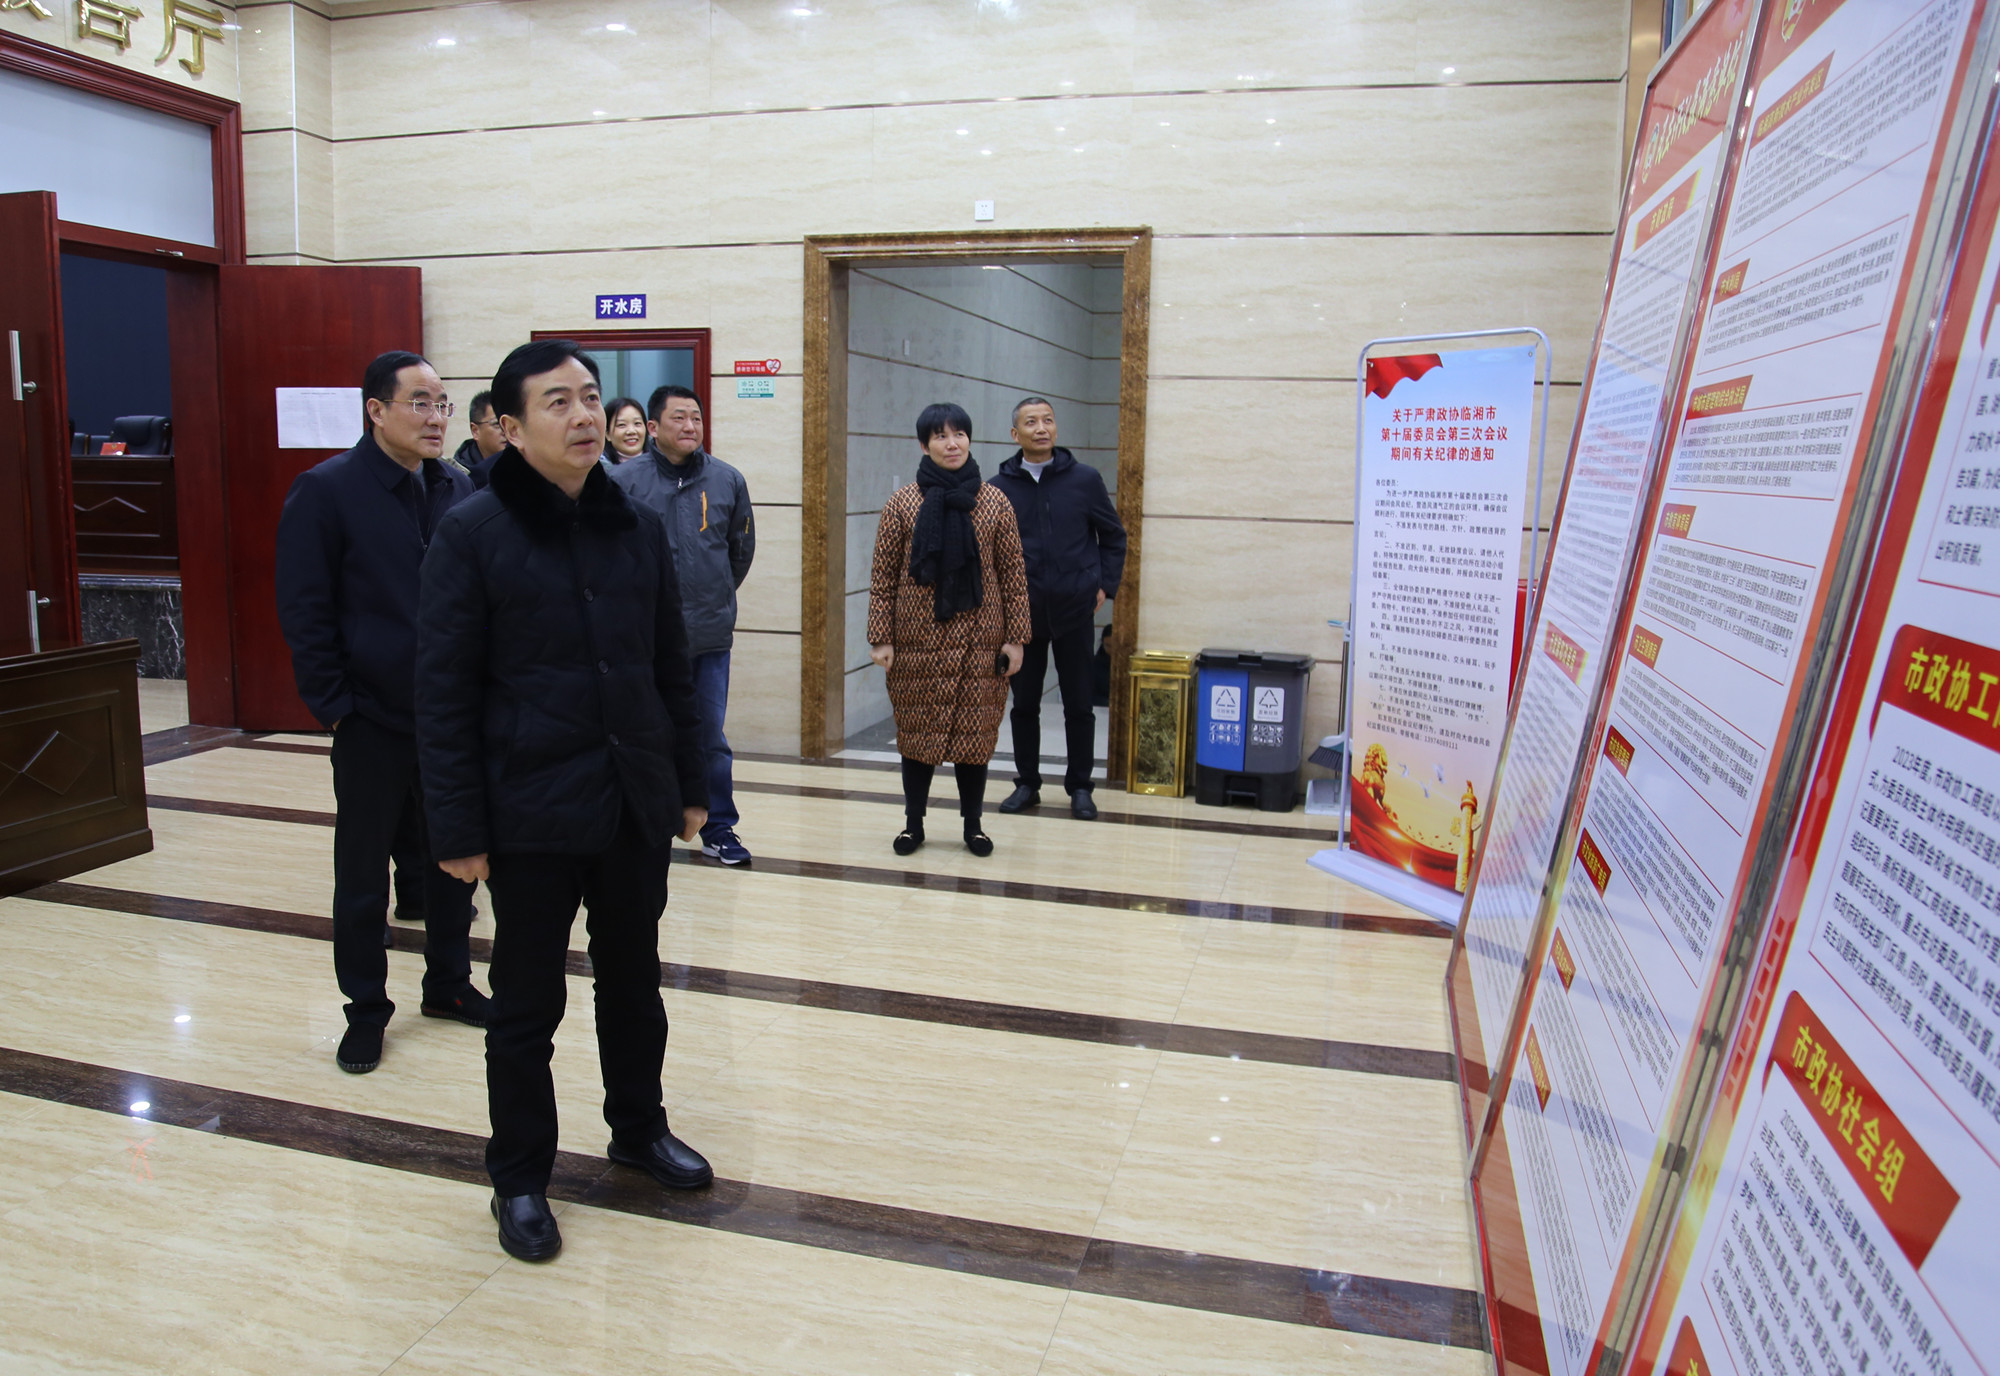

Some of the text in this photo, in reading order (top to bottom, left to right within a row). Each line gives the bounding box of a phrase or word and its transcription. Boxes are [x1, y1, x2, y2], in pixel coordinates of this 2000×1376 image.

[600, 298, 643, 315] 开水房
[1392, 405, 1497, 422] 关于严肃政协临湘市
[1381, 426, 1508, 442] 第十届委员会第三次会议
[1391, 447, 1494, 461] 期间有关纪律的通知
[1904, 647, 2000, 729] 市政协工
[1791, 1024, 1905, 1204] 市政协社会组
